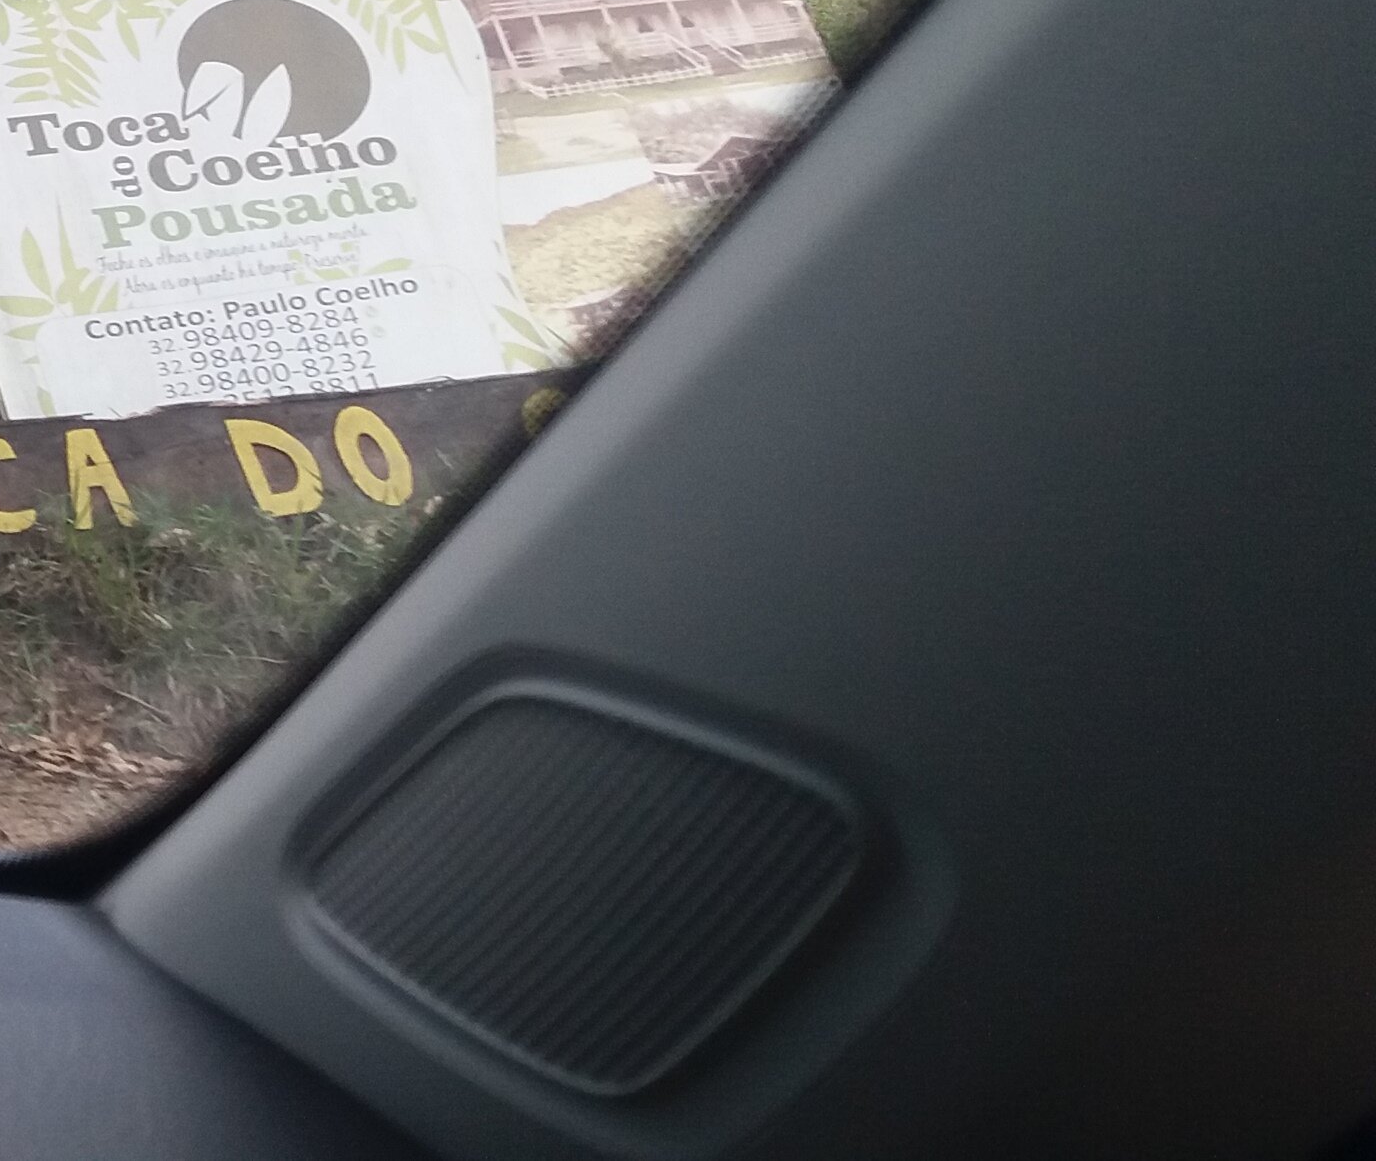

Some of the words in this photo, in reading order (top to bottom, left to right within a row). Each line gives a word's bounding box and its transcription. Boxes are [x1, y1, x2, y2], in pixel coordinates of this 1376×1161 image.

[7, 110, 190, 157] Toca
[110, 155, 143, 197] do
[148, 132, 397, 193] Coelho
[91, 175, 417, 250] Pousada
[84, 309, 216, 340] Contato:
[222, 293, 307, 321] Paulo
[314, 278, 420, 307] Coelho
[150, 306, 359, 355] 32.98409-8284
[157, 327, 369, 377] 32.98429-4846
[164, 350, 377, 399] 32.98400-8232
[223, 404, 415, 518] DO
